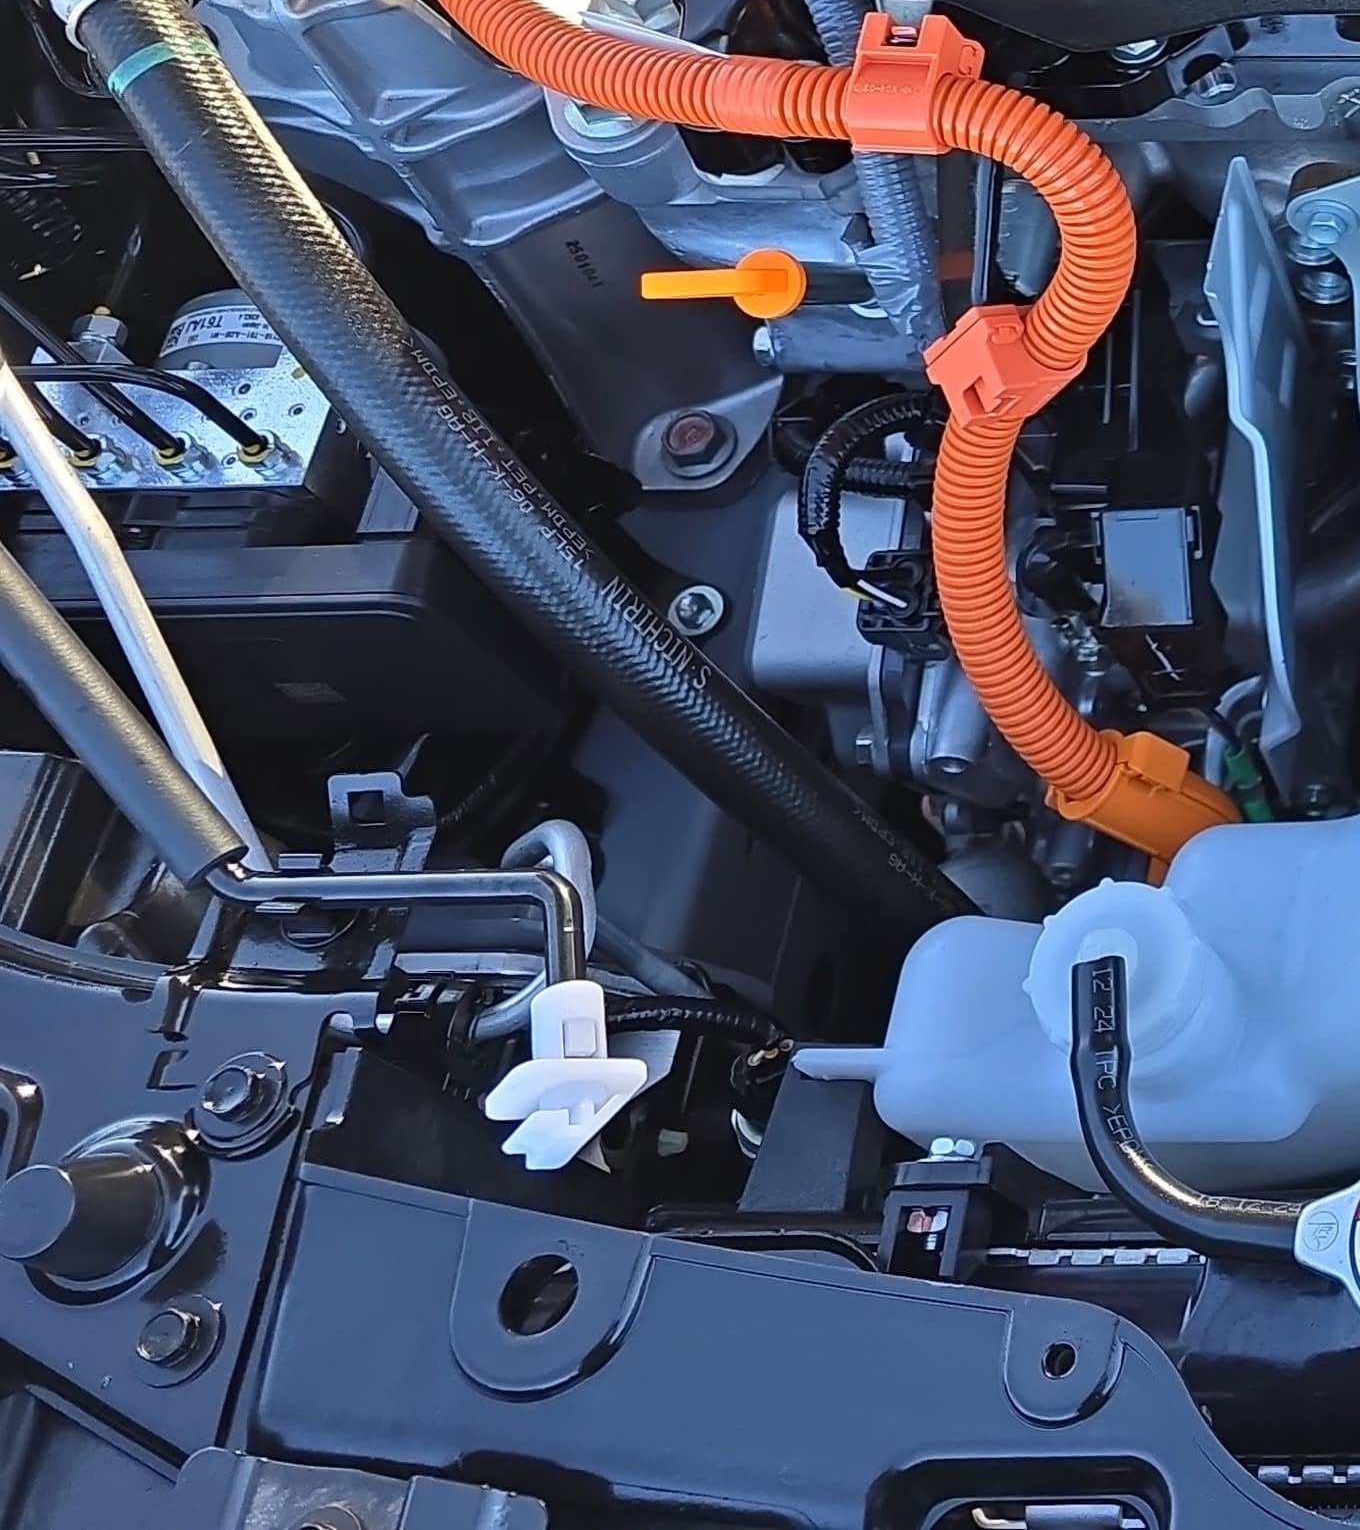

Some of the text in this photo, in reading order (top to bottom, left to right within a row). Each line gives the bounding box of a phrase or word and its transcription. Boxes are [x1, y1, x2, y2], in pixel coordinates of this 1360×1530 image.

[183, 314, 224, 333] T61AJ
[1091, 968, 1117, 1089] 12 24 TPC
